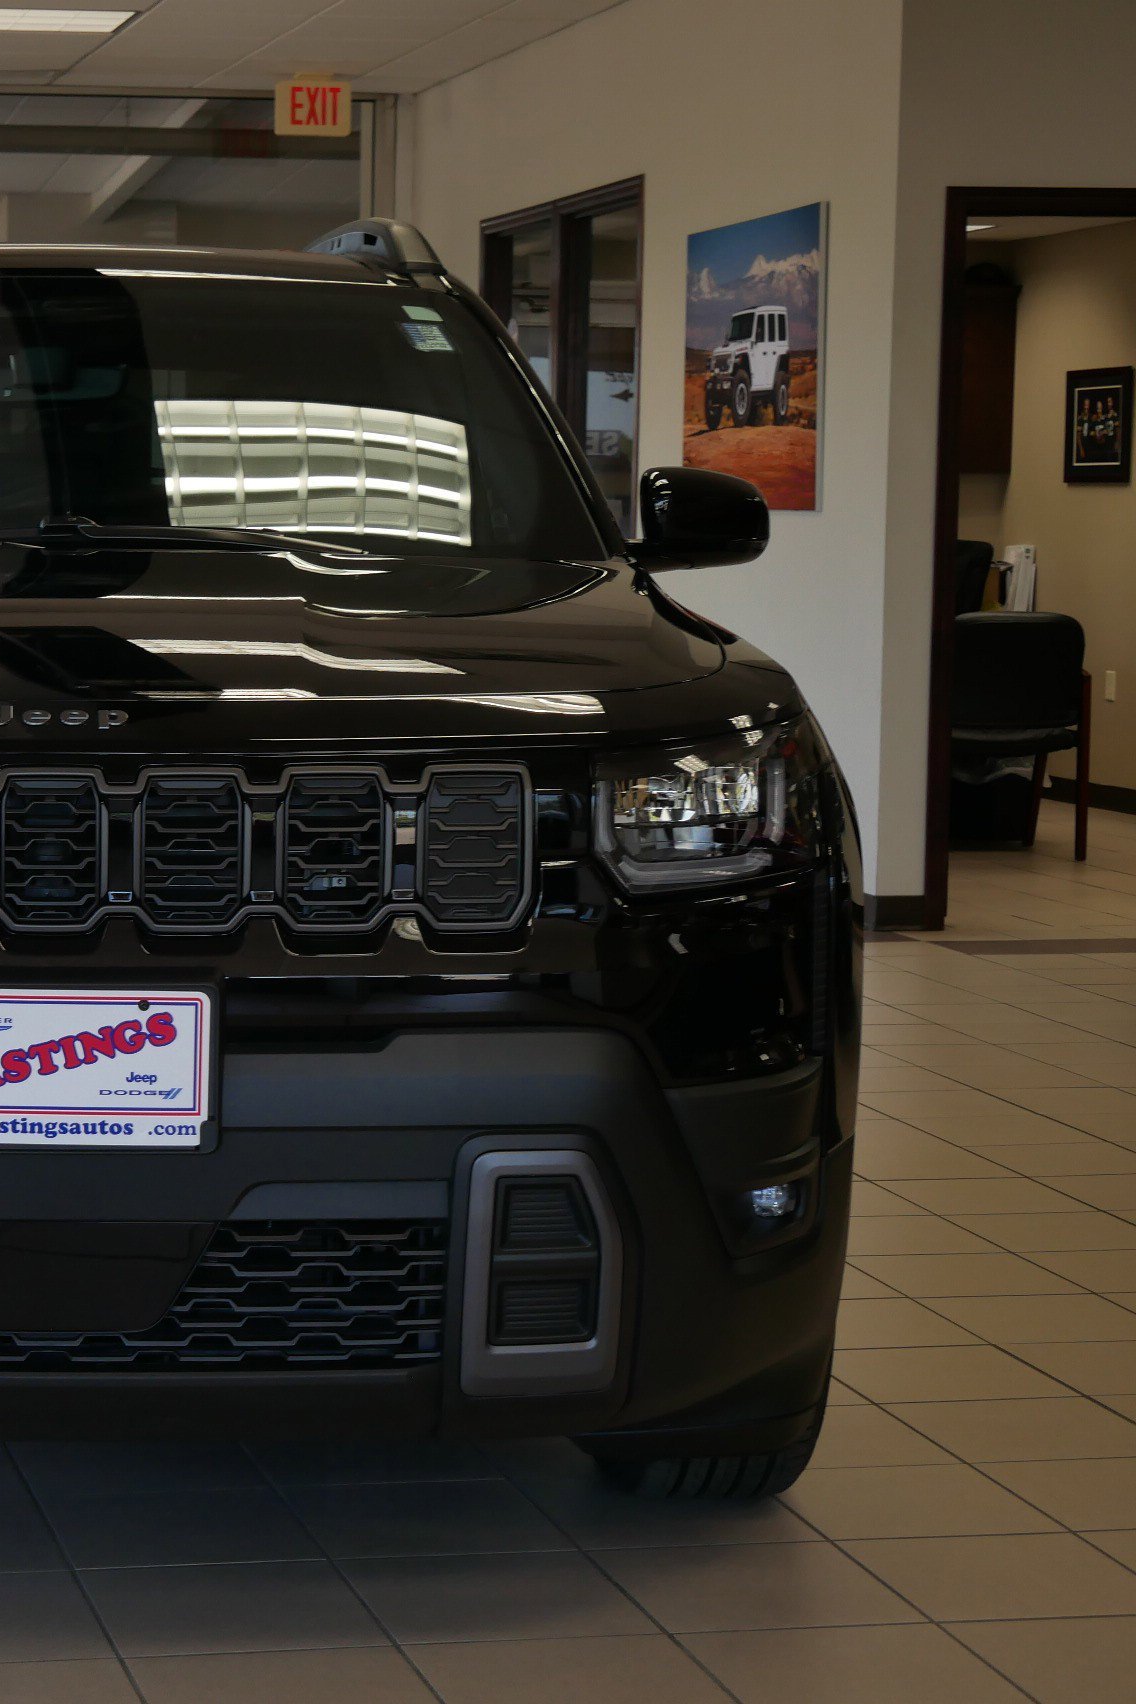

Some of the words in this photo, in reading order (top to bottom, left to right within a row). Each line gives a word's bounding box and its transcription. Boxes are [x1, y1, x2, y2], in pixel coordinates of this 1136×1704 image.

[290, 86, 342, 126] EXIT
[126, 1071, 157, 1085] Jeep
[99, 1089, 171, 1097] DODGE
[148, 1123, 197, 1136] .com
